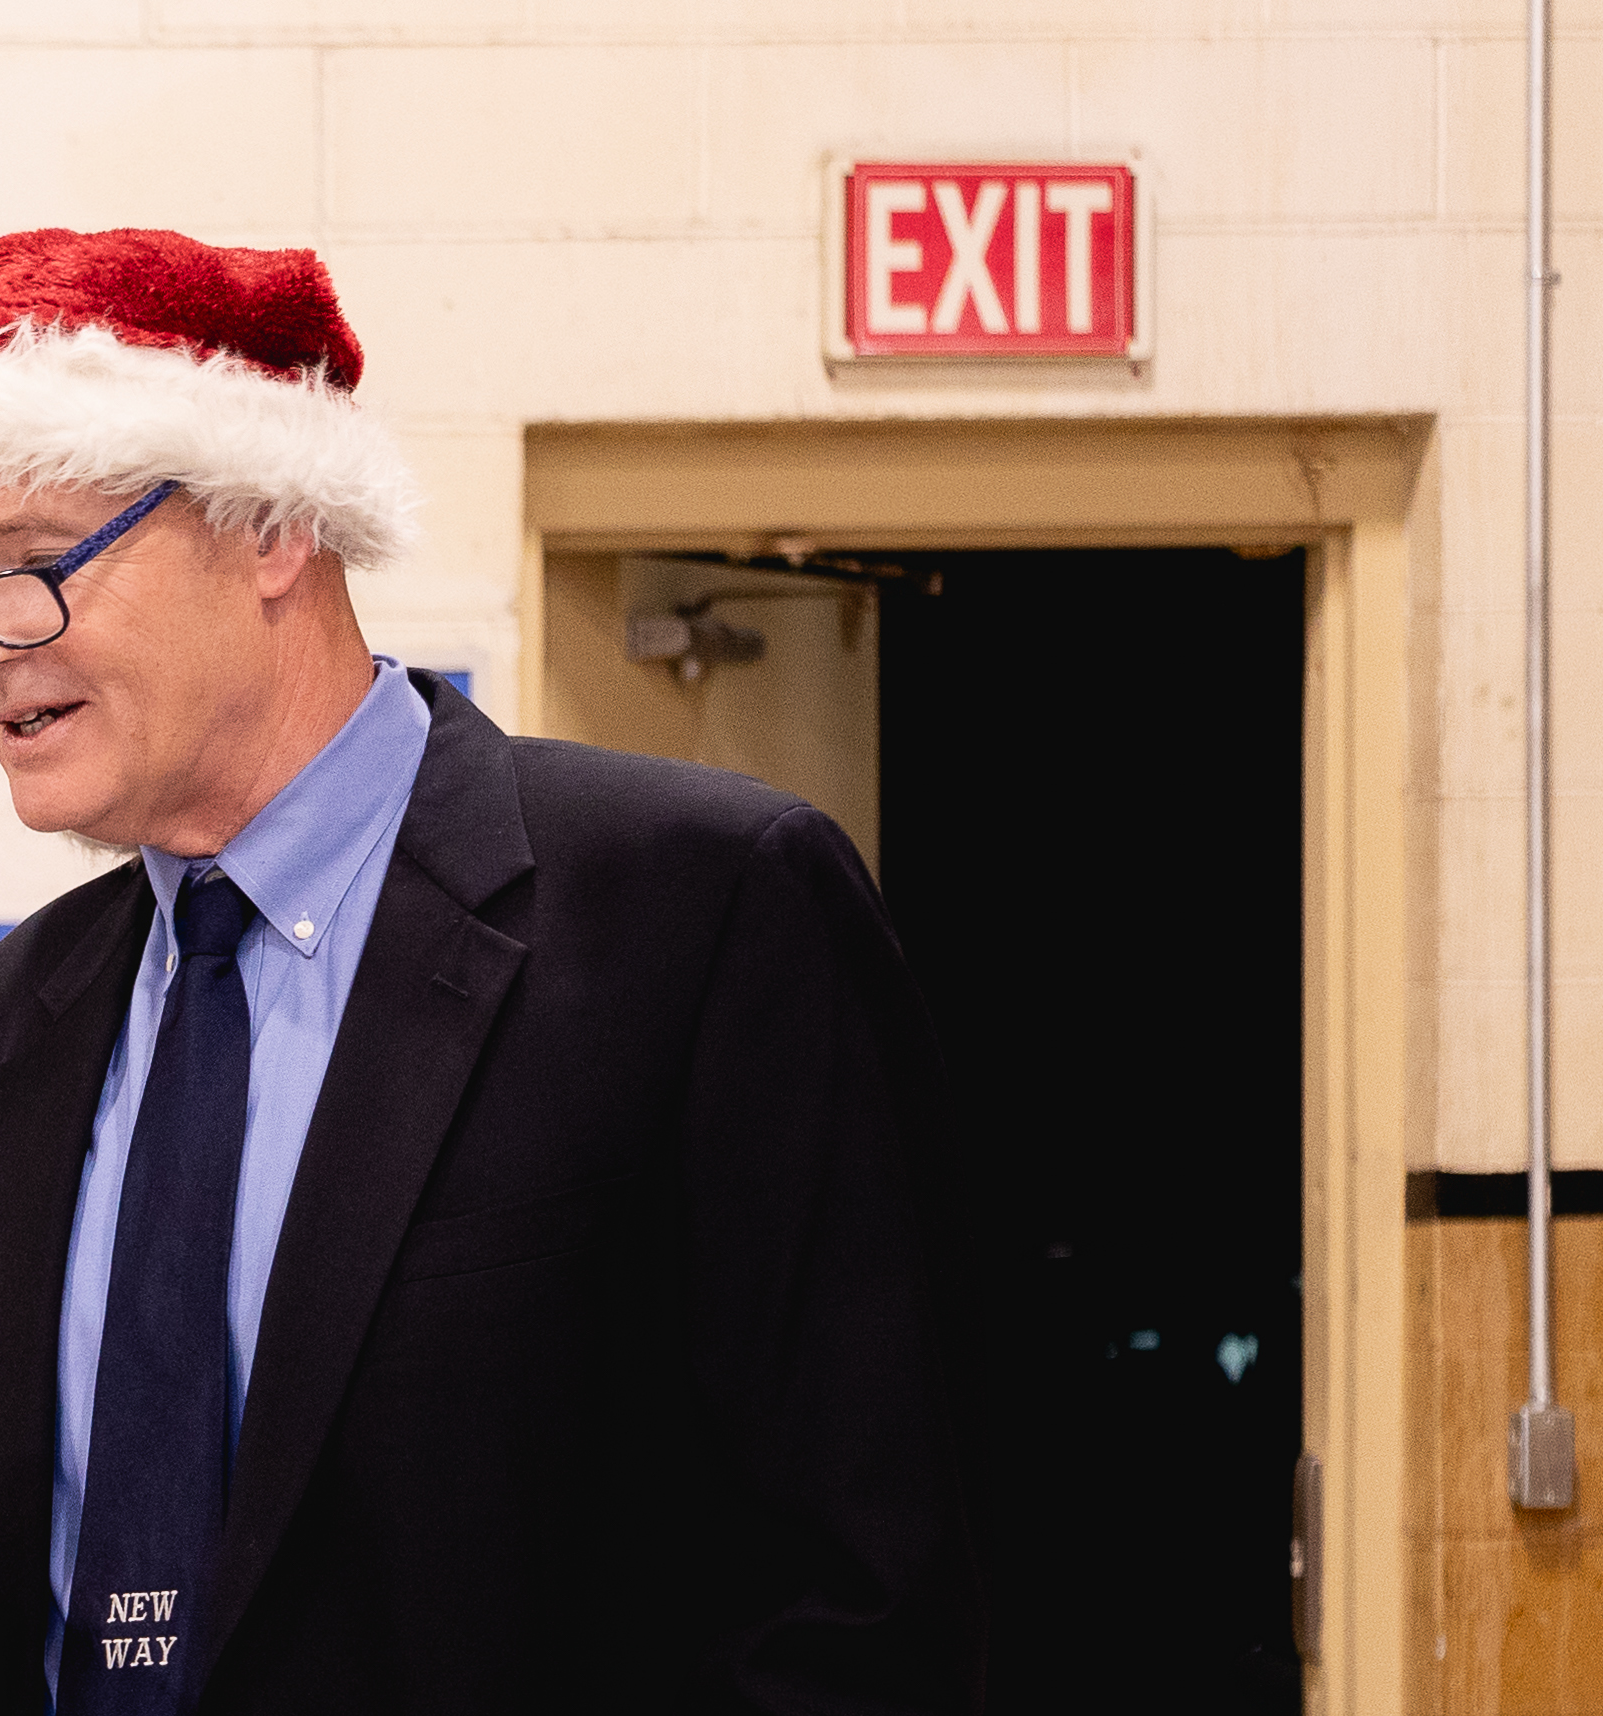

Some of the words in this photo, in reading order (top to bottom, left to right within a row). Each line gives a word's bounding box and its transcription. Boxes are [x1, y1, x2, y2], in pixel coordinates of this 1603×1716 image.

[866, 180, 1114, 336] EXIT
[106, 1590, 179, 1624] NEW
[101, 1636, 178, 1670] WAY
